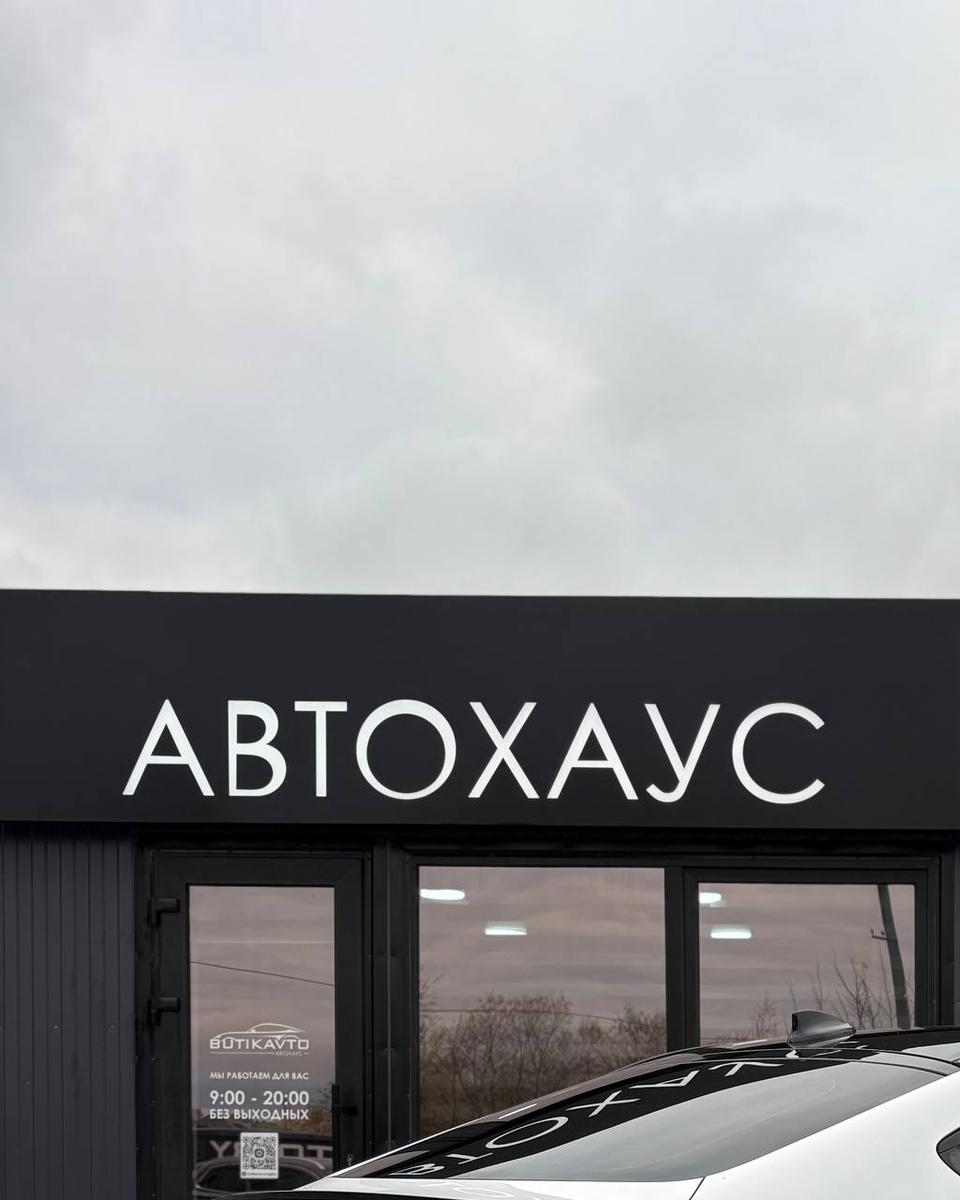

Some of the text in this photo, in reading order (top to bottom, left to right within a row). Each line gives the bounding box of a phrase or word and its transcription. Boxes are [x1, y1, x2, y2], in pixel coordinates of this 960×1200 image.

[122, 698, 825, 806] АВТОХАУС
[210, 1039, 309, 1050] BUTIKAVTO
[209, 1071, 309, 1081] МЫ РАБОТАЕМ ДЛЯ ВАС
[209, 1090, 245, 1106] 9:00
[263, 1090, 309, 1106] 20:00
[209, 1108, 309, 1121] БЕЗ ВЫХОДНЫХ
